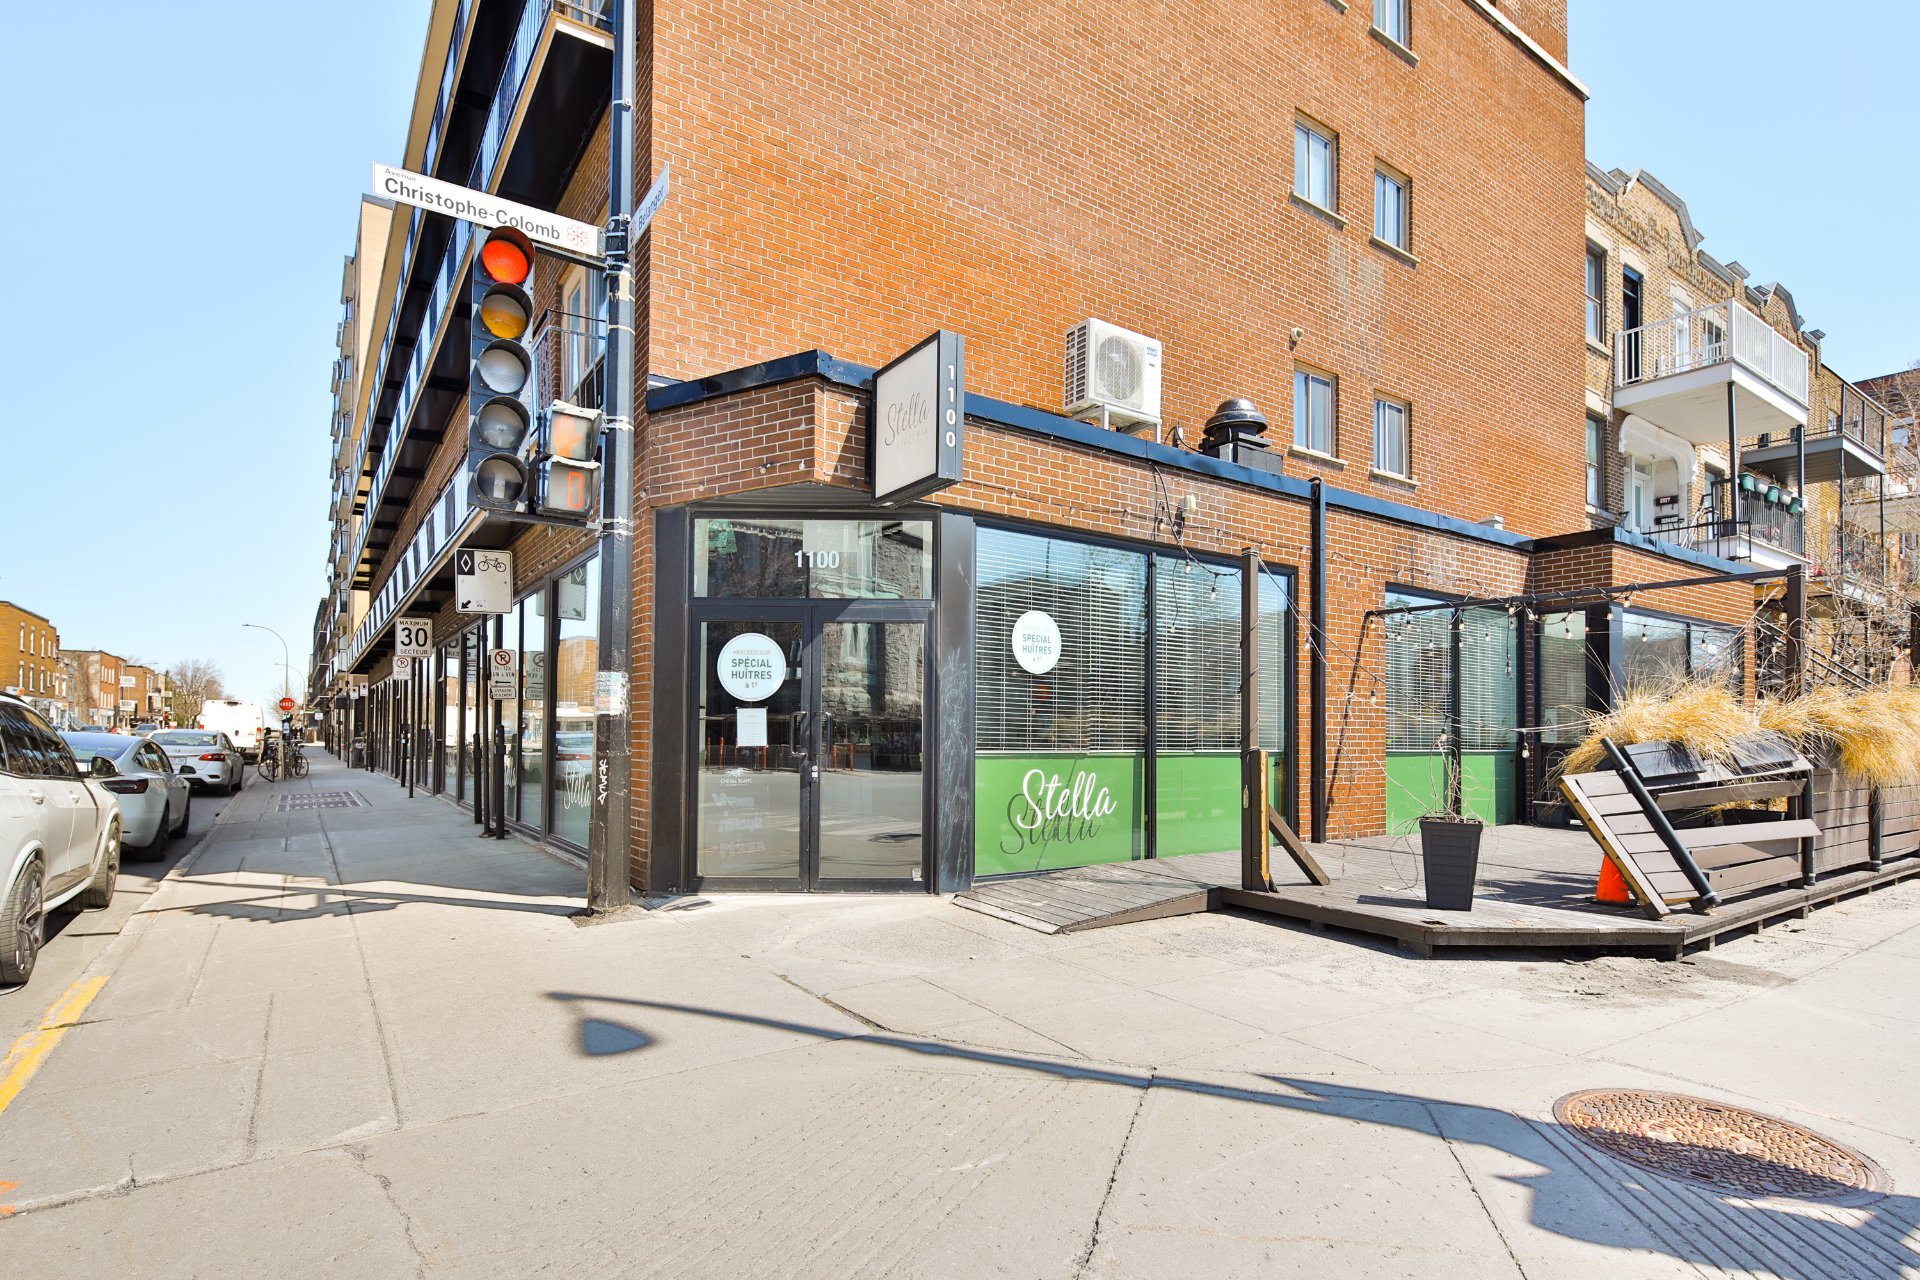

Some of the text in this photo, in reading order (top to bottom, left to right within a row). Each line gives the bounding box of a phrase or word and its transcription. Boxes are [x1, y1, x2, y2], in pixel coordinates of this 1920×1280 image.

[384, 168, 417, 182] Avenue
[384, 177, 560, 240] Christophe-Colomb
[945, 364, 956, 448] 1100
[884, 392, 930, 446] Stella
[795, 550, 840, 569] 1100
[400, 626, 428, 648] 30
[1022, 632, 1052, 644] SPÉCIAL
[1022, 643, 1053, 655] HUÎTRES
[731, 656, 772, 668] SPÉCIAL
[731, 668, 773, 680] HUÎTRES
[563, 761, 591, 810] Stella
[1016, 769, 1117, 829] Stella
